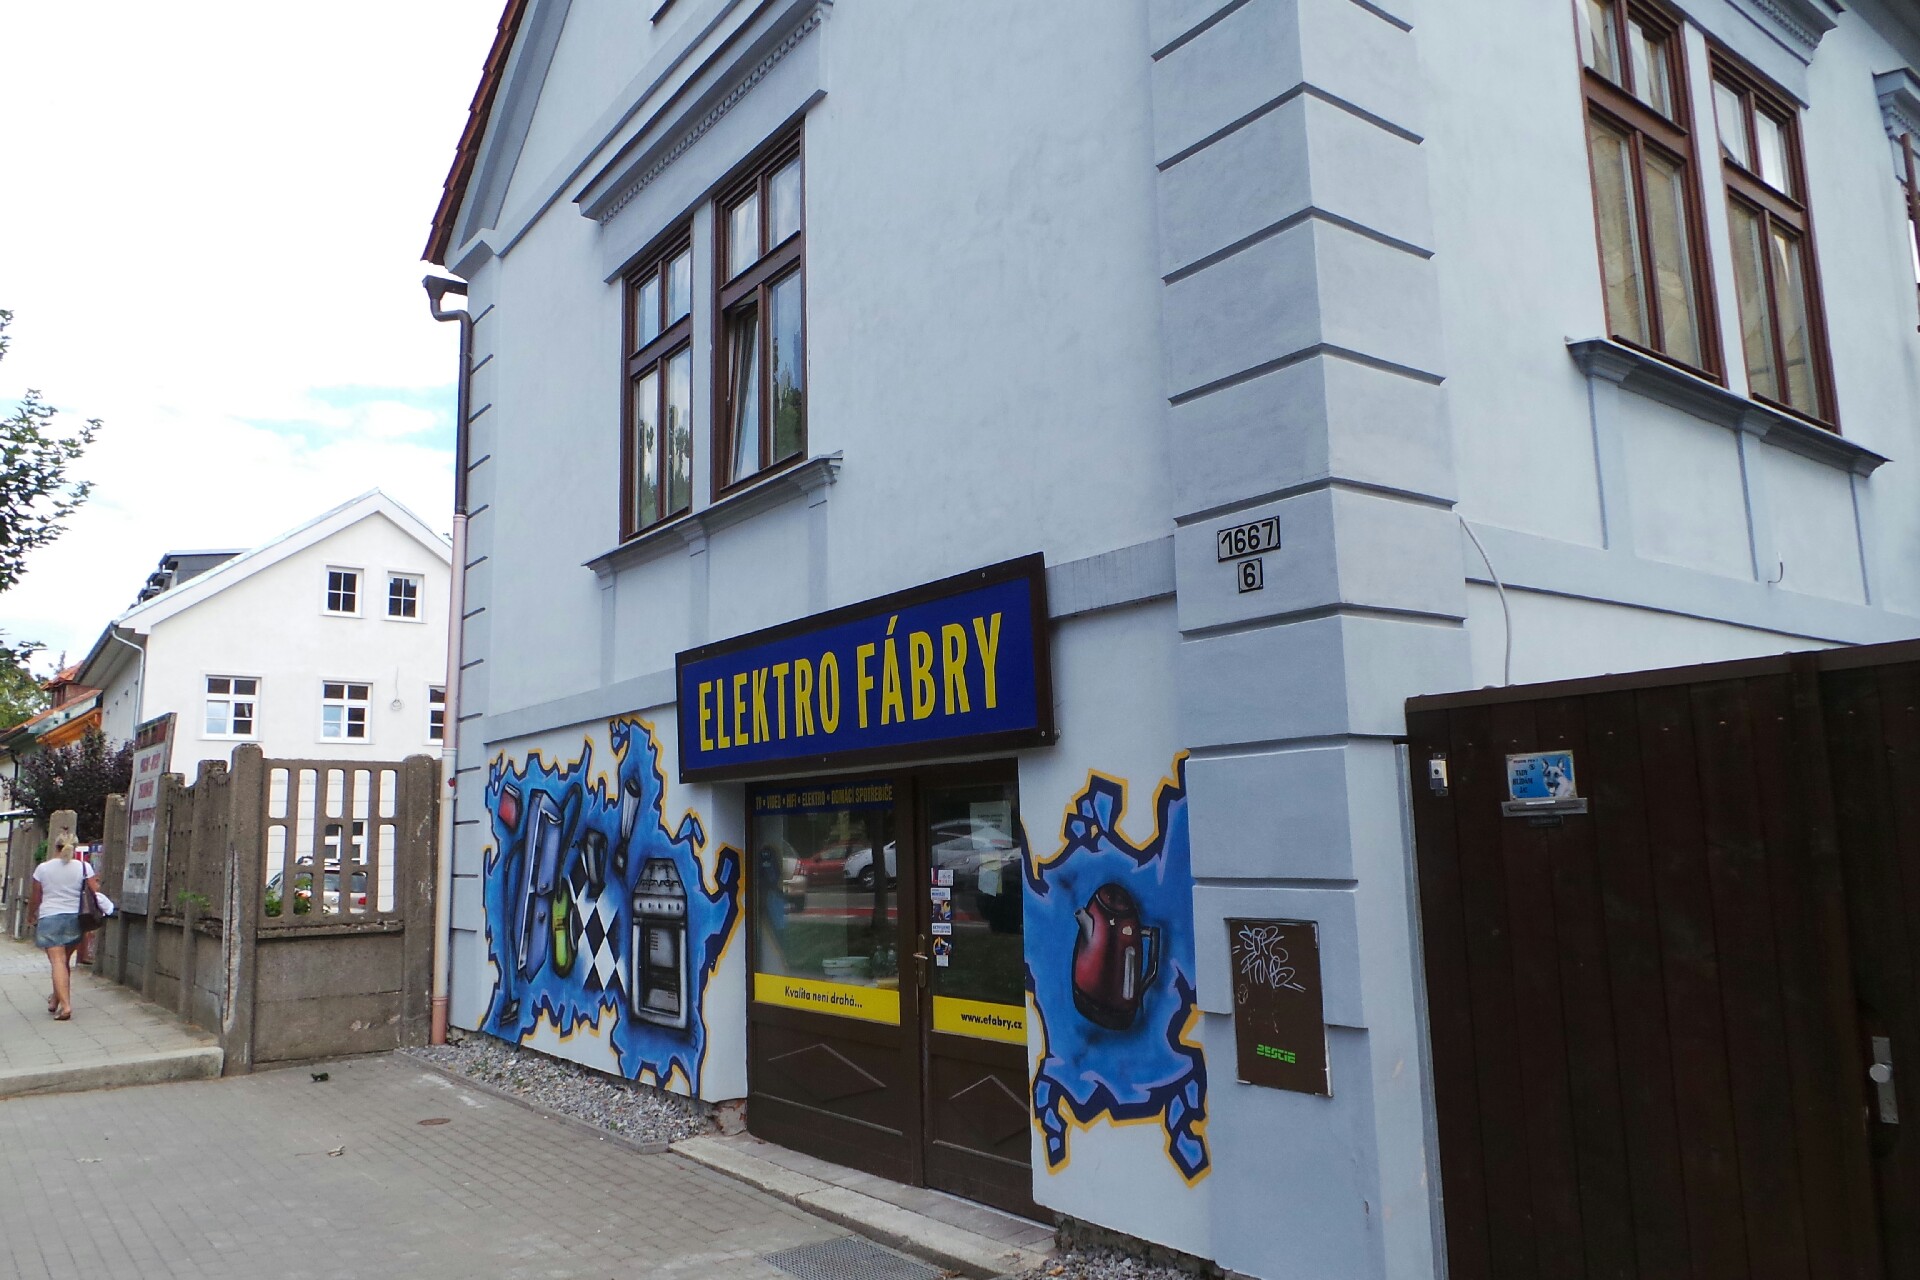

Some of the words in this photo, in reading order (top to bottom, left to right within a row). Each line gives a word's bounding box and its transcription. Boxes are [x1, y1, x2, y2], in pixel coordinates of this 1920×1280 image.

[1221, 521, 1274, 555] 1667
[1243, 562, 1256, 588] 6
[698, 651, 841, 752] ELEKTRO
[856, 612, 1002, 729] FÁBRY
[767, 794, 781, 809] VIDEO
[802, 791, 826, 807] ELEKTRO
[785, 986, 811, 1000] Kvalita
[961, 1013, 1023, 1030] www.efabry.cz
